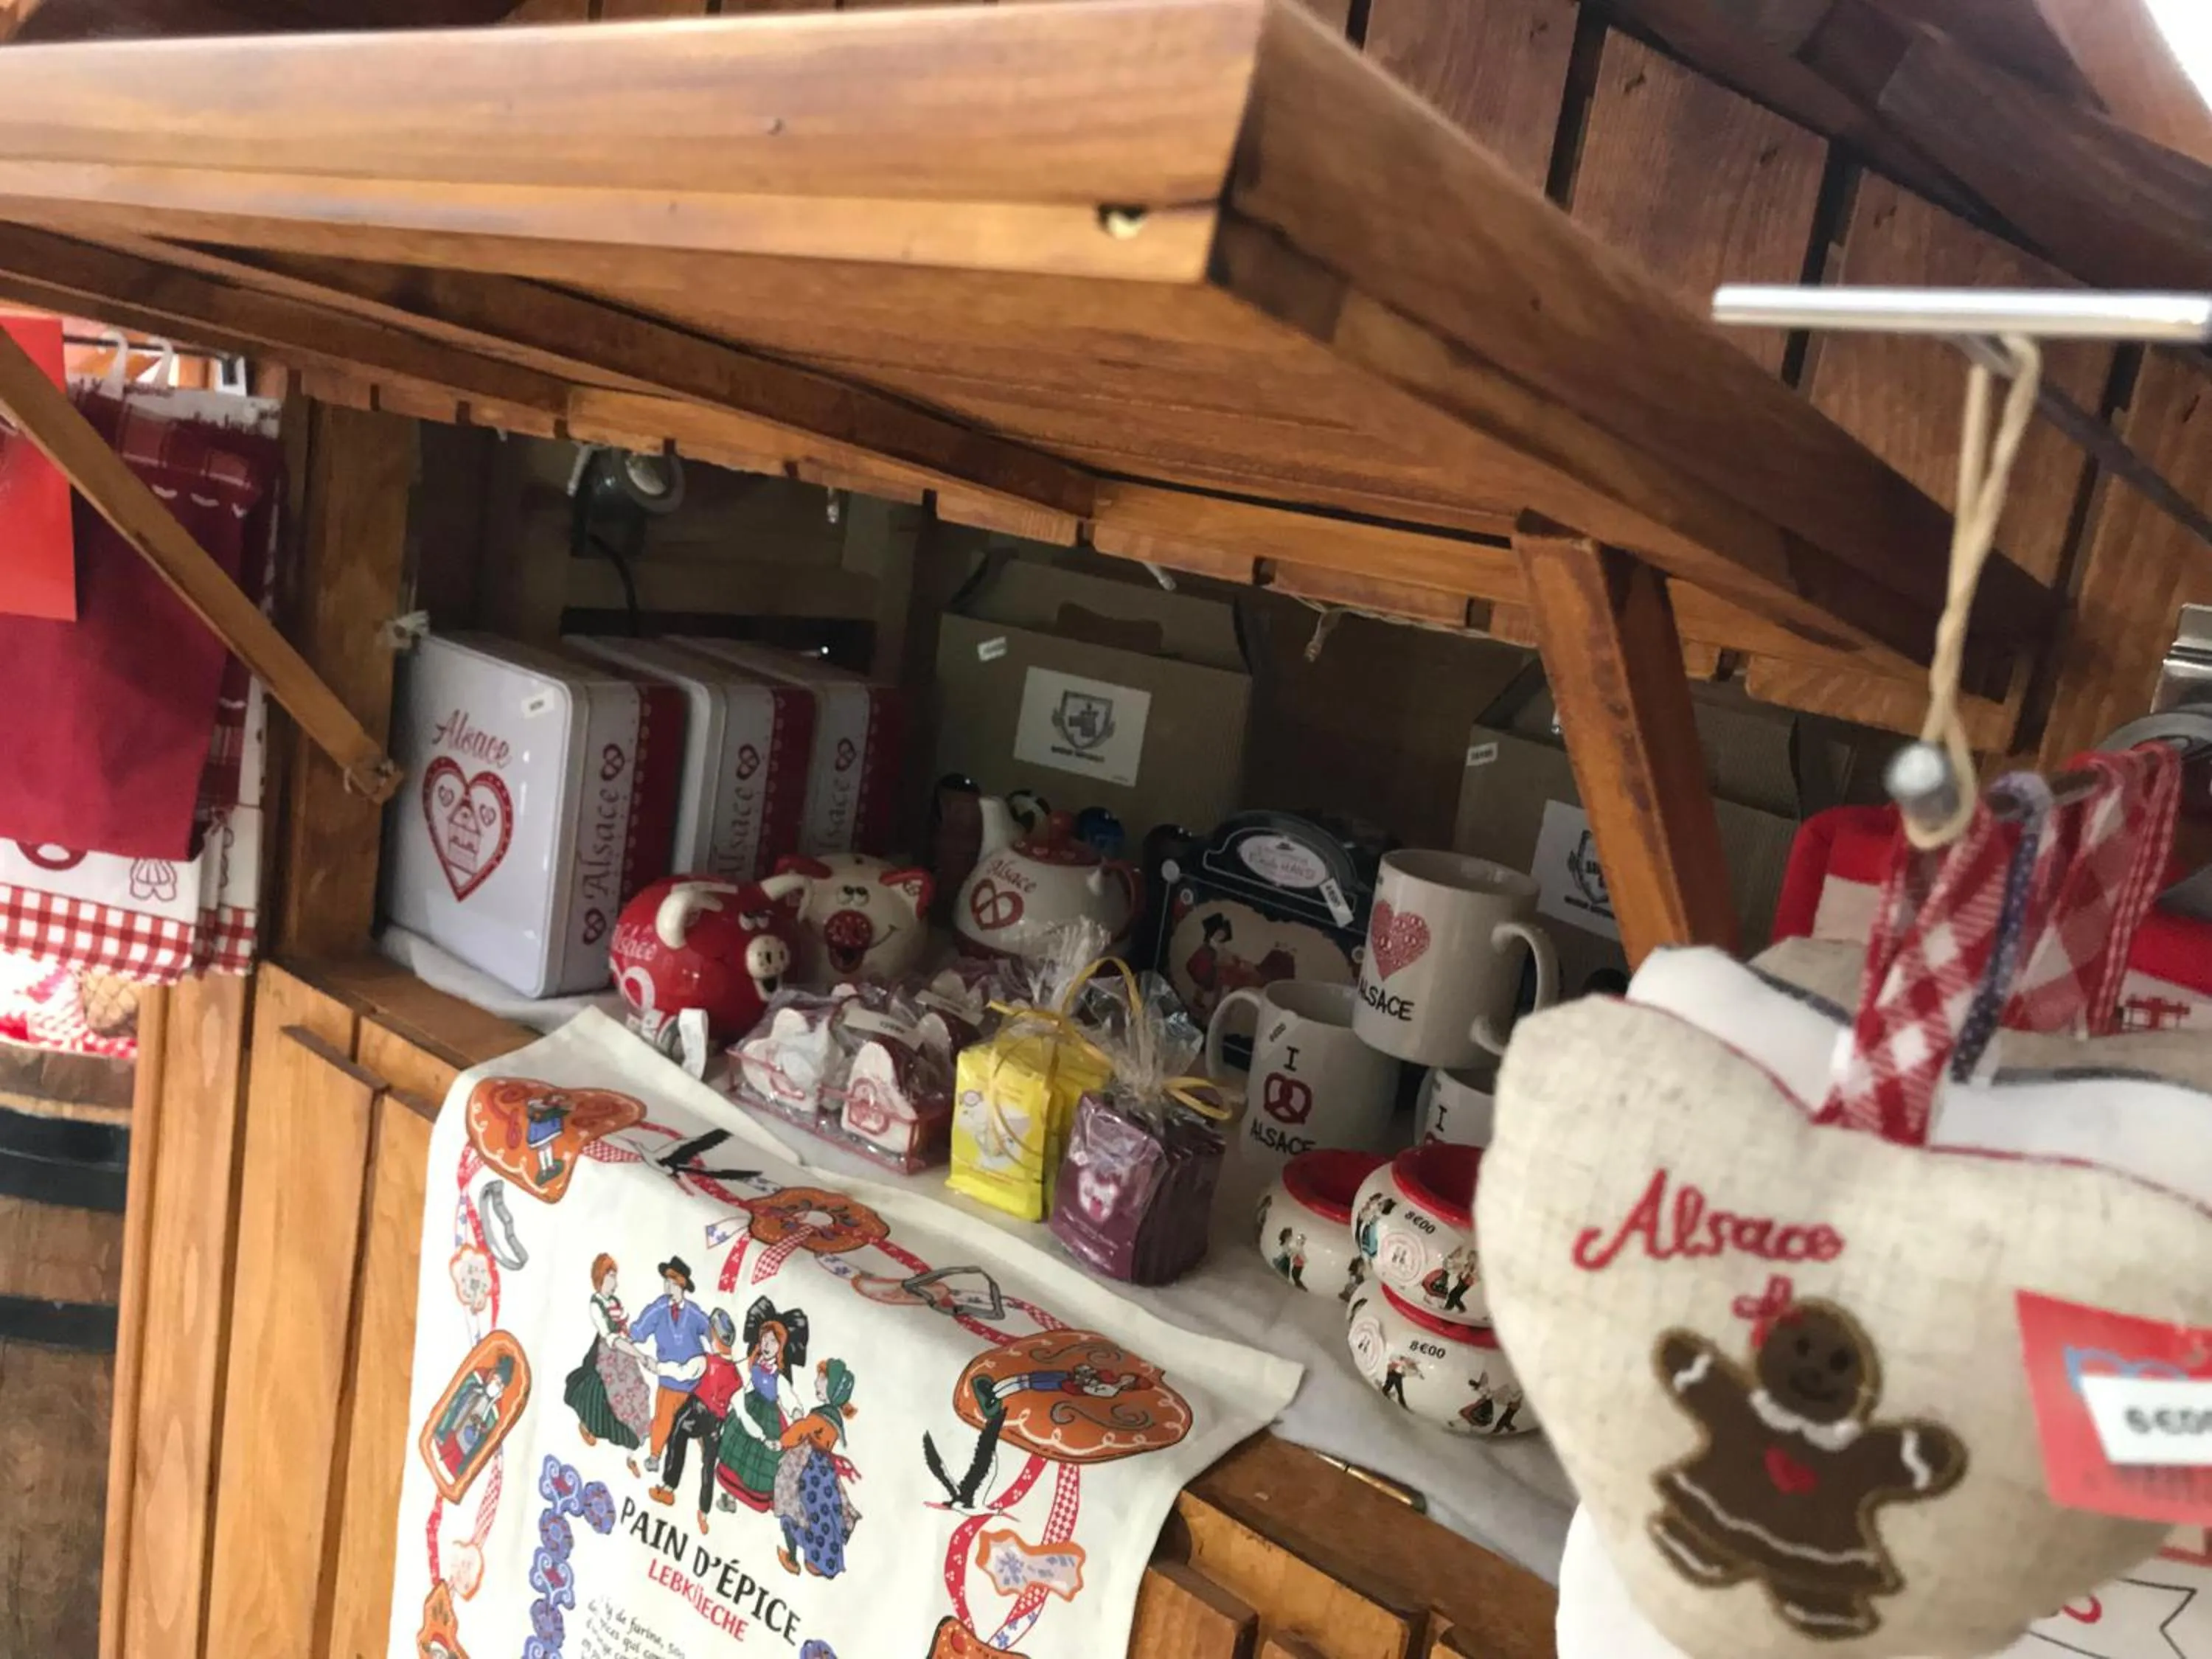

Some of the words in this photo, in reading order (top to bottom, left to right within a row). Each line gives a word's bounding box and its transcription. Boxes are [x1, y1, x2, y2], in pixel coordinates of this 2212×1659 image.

[432, 709, 512, 768] Alsace
[818, 776, 850, 850] lsace
[582, 787, 619, 900] Alsace
[1283, 1045, 1300, 1072] I
[1434, 1105, 1447, 1133] I
[1404, 1210, 1436, 1235] 8€00
[1571, 1166, 1847, 1272] Alsace
[1410, 1339, 1447, 1360] 8€00
[620, 1495, 689, 1562] PAIN
[692, 1545, 801, 1646] D'ÉPICE
